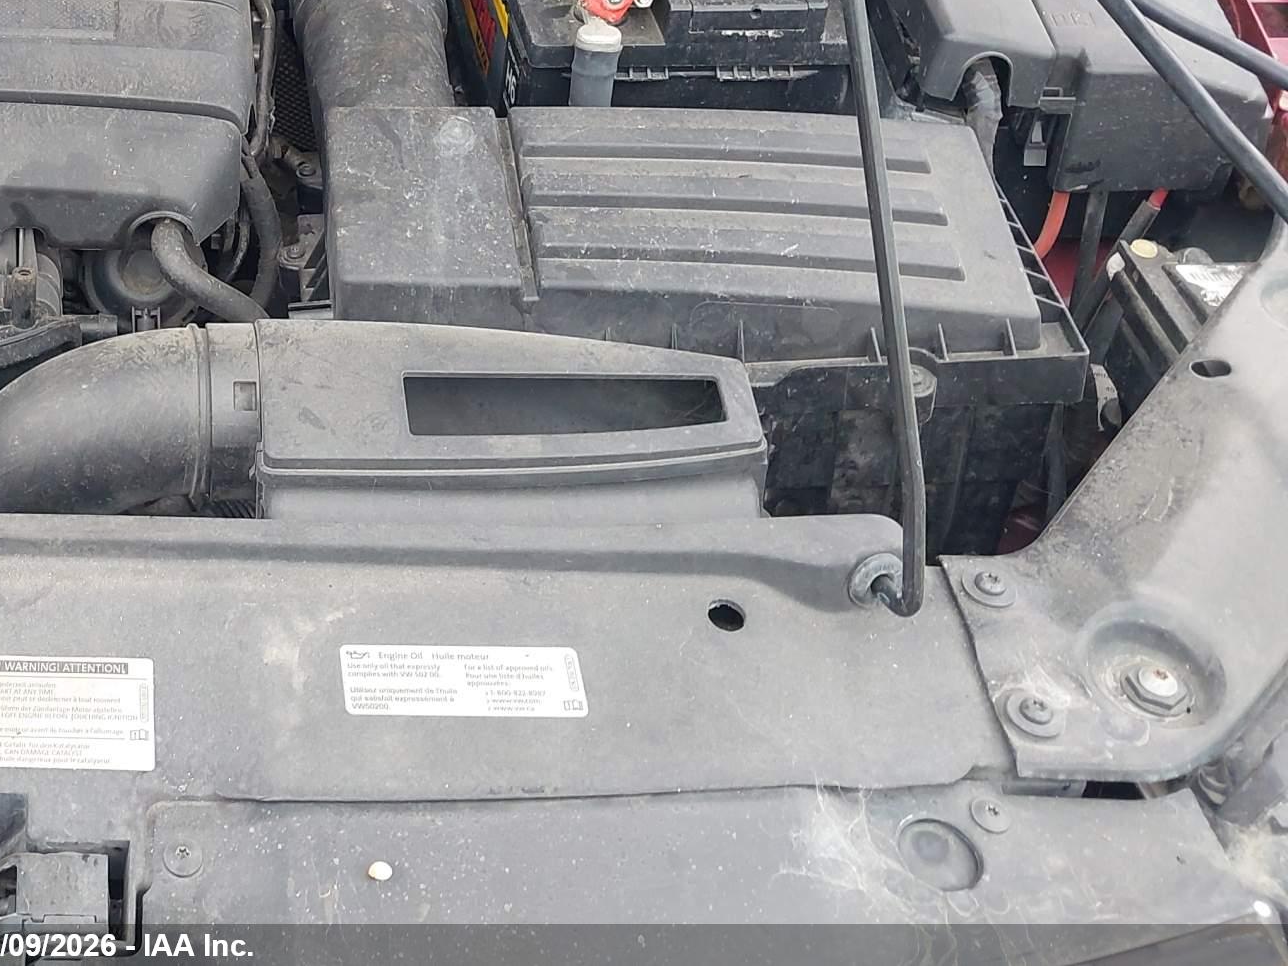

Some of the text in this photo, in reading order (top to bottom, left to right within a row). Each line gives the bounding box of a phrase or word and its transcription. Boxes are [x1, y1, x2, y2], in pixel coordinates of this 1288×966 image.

[378, 652, 423, 661] Engine Oil
[431, 652, 489, 661] Huile moteur
[4, 661, 60, 673] WARNING!
[62, 662, 126, 674] ATTENTION!
